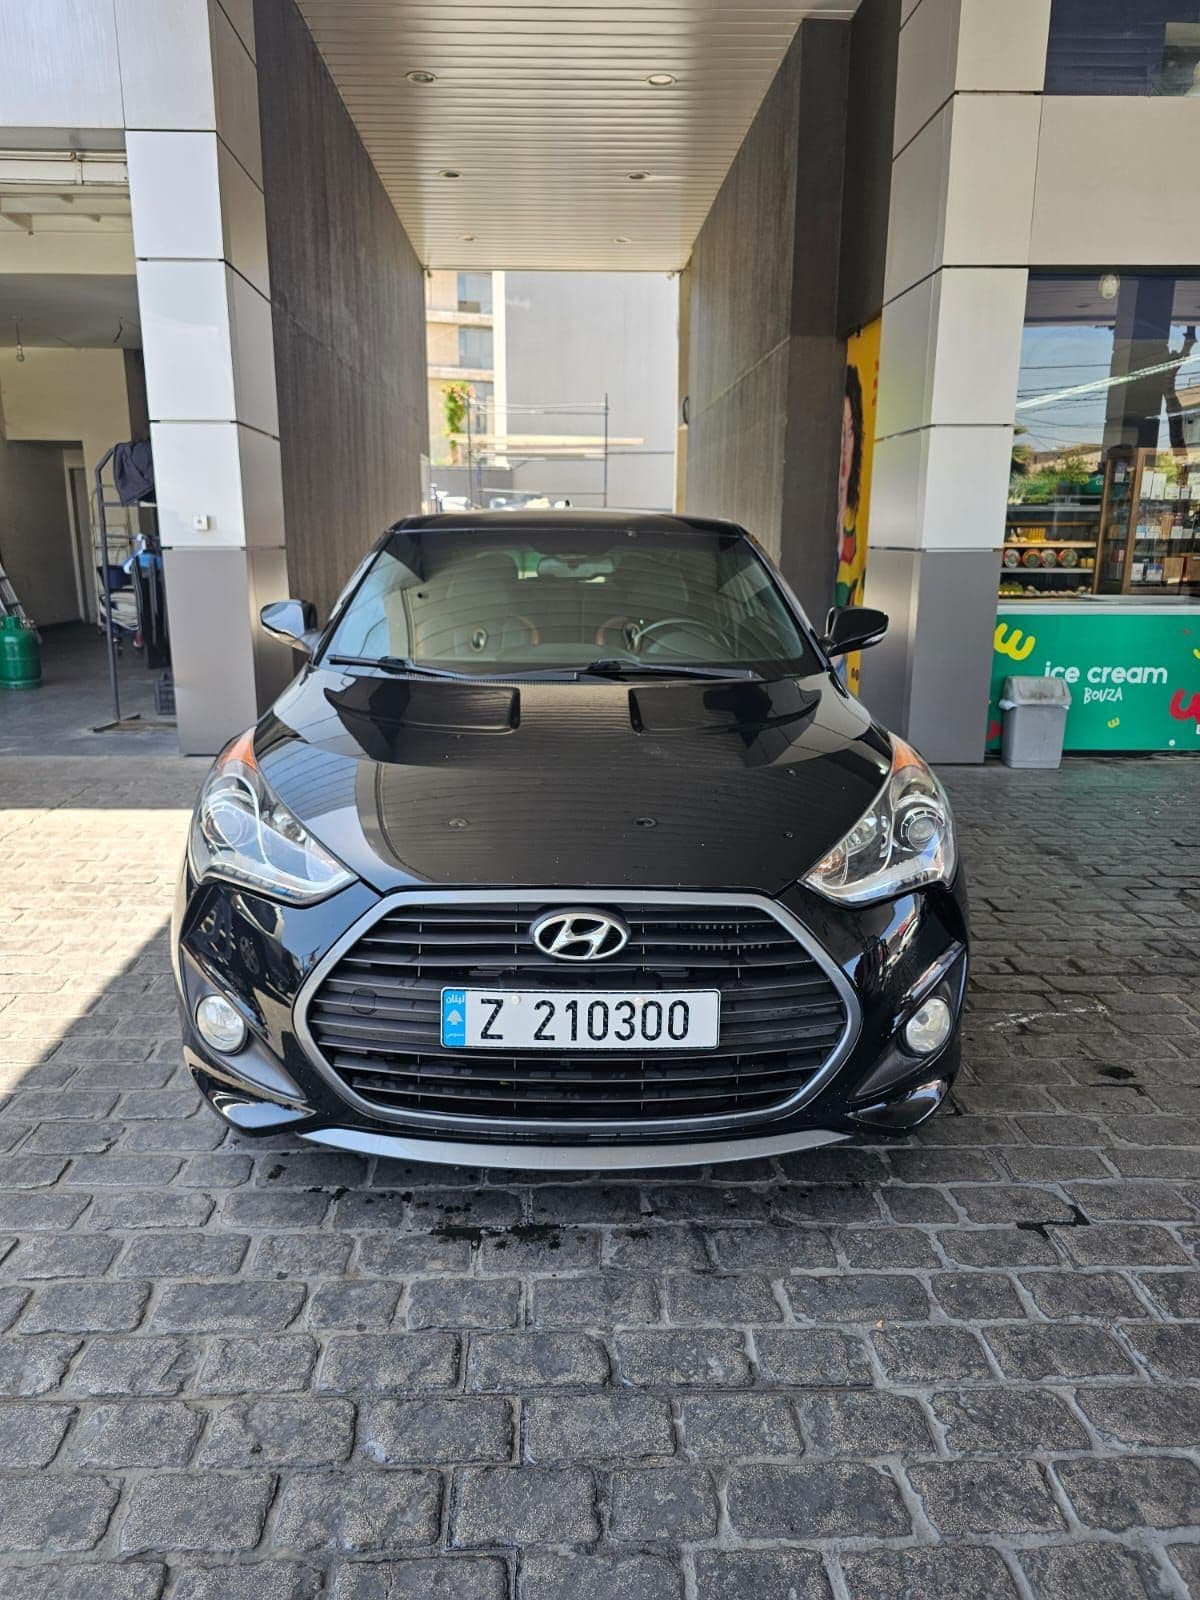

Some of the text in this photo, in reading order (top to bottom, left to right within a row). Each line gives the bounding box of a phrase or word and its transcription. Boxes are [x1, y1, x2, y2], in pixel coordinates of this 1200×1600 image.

[1044, 661, 1168, 684] ice cream
[480, 998, 690, 1041] Z 210300
